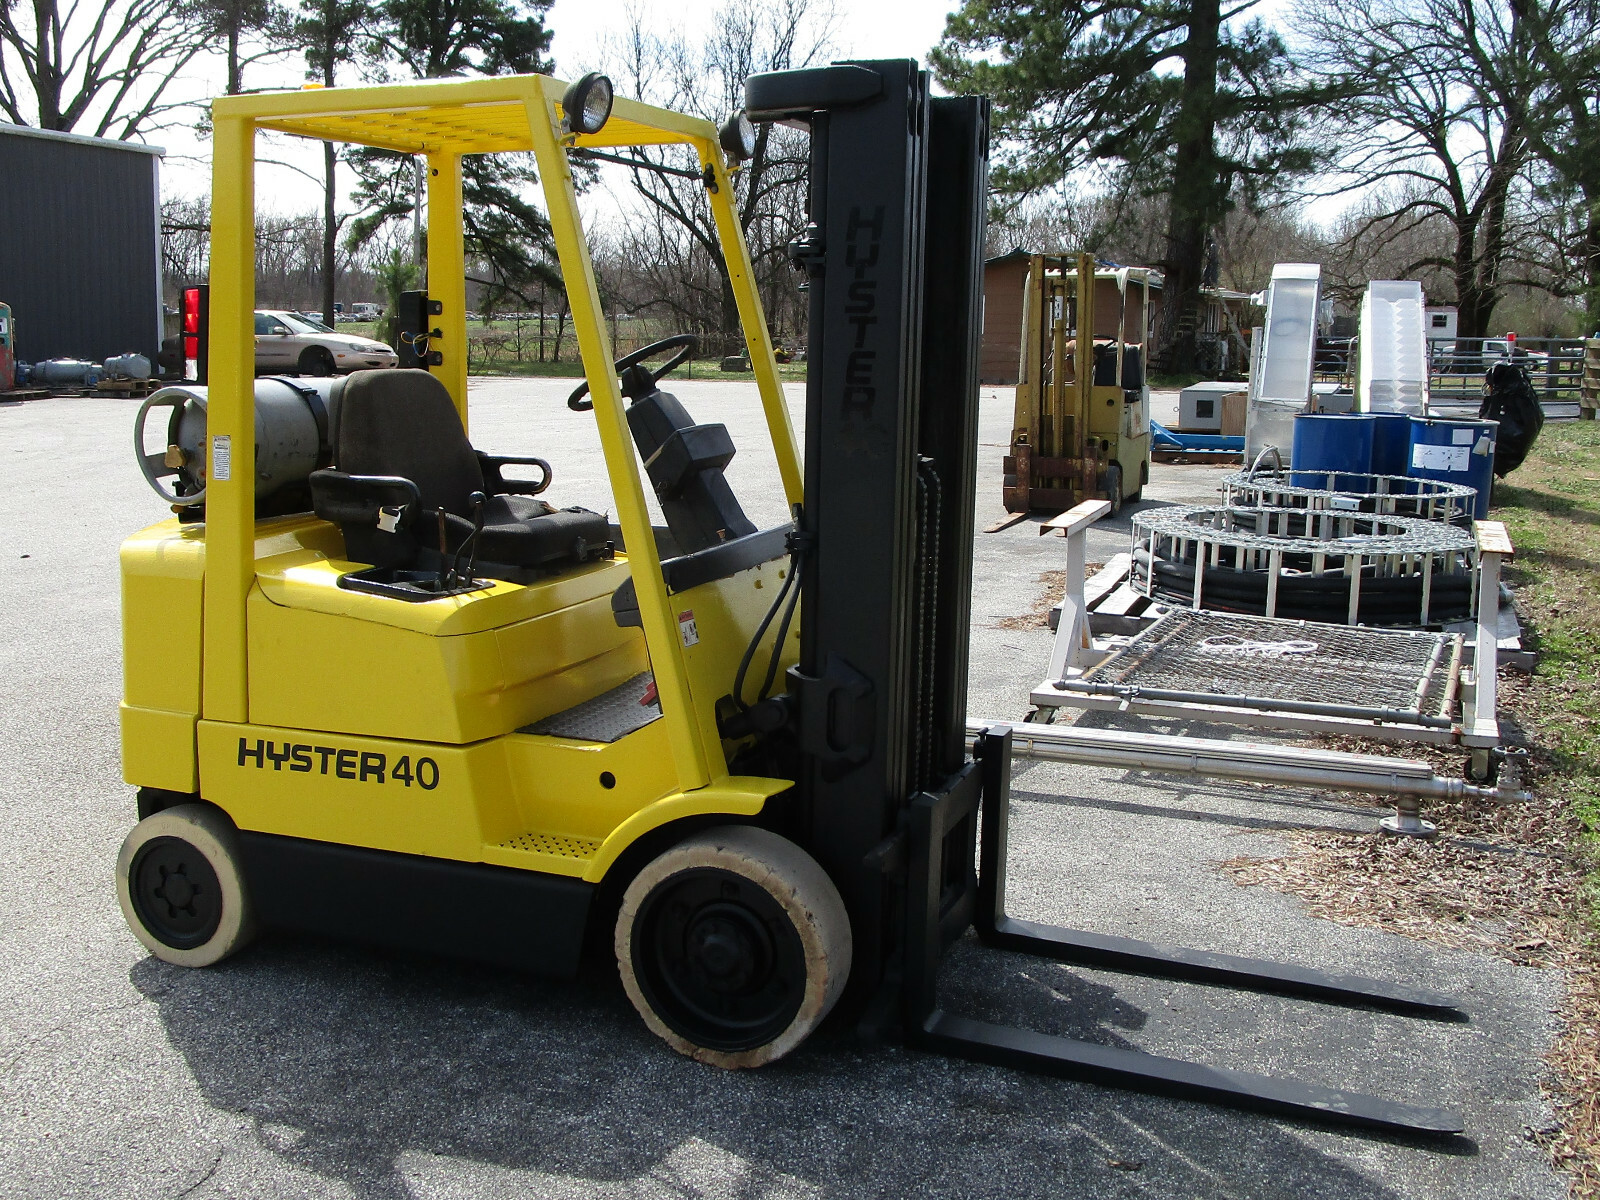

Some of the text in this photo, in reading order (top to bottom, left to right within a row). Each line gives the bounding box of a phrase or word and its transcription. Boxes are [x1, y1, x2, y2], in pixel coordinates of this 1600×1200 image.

[841, 205, 886, 421] HYSTER
[237, 737, 440, 791] HYSTER 40
